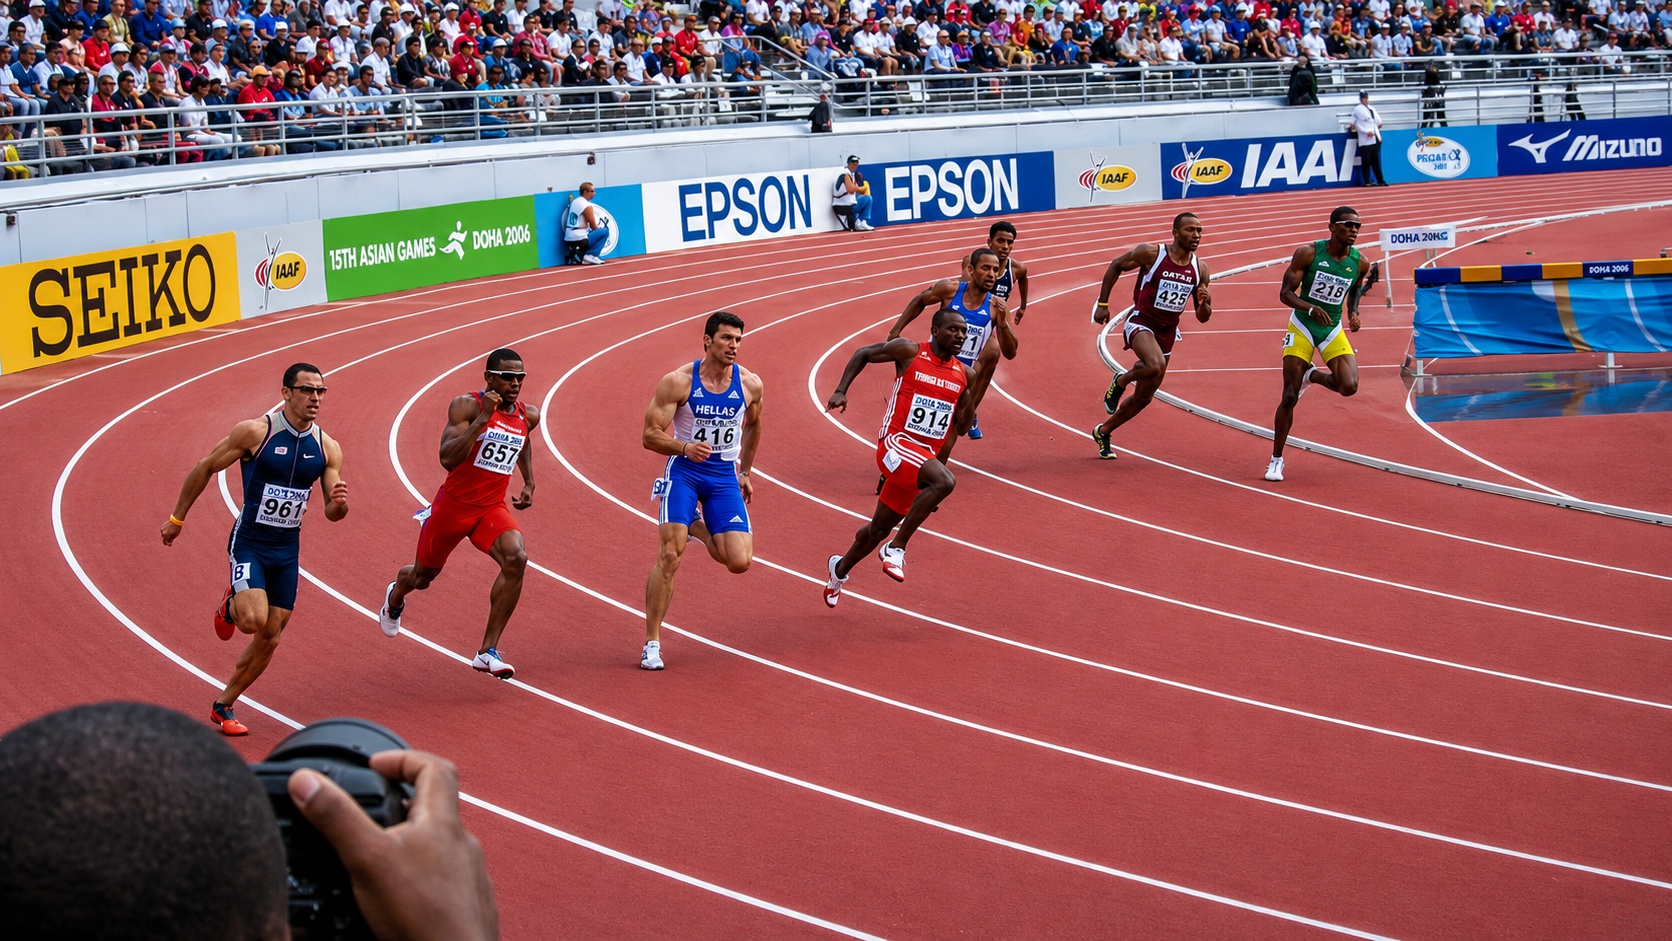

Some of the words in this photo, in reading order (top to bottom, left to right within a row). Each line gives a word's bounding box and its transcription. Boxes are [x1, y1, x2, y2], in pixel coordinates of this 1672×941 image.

[1101, 172, 1129, 184] IAAF
[1195, 165, 1224, 177] IAAF
[884, 158, 1019, 222] EPSON
[678, 174, 812, 243] EPSON
[472, 229, 504, 250] DOHA
[505, 224, 531, 246] 2006
[1391, 233, 1420, 244] DOHA
[329, 248, 357, 270] 15TH
[360, 242, 395, 266] ASIAN
[397, 237, 436, 262] GAMES
[276, 261, 300, 280] IAAF
[1158, 290, 1187, 306] 425
[1315, 281, 1344, 298] 218
[29, 244, 216, 357] SEIKO
[695, 404, 735, 417] HELLAS
[911, 407, 949, 430] 914
[694, 428, 734, 445] 416
[481, 442, 519, 465] 657
[263, 498, 303, 518] 961
